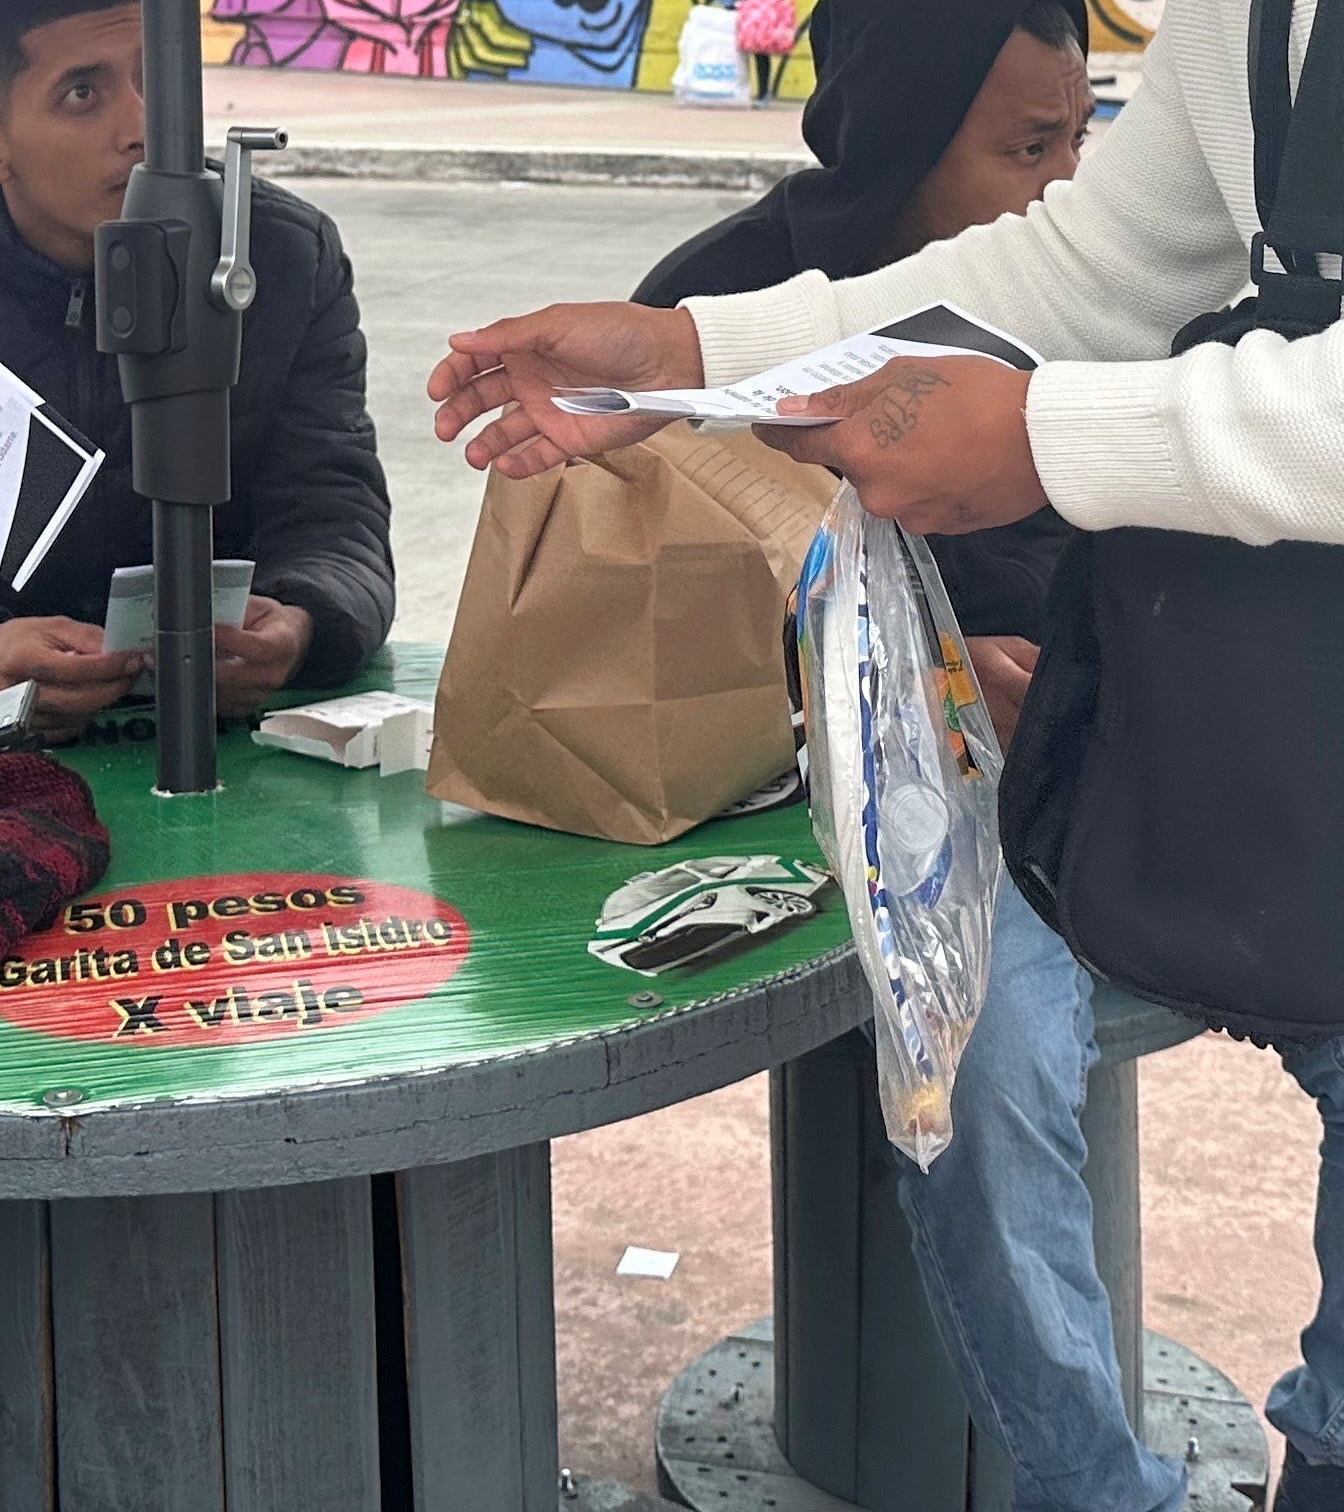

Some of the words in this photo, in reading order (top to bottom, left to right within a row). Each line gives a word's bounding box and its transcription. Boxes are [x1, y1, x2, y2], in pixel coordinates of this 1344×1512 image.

[64, 899, 146, 935] 50
[167, 884, 365, 929] pesos
[151, 938, 211, 972] de
[223, 929, 312, 965] San
[183, 979, 364, 1029] viaje
